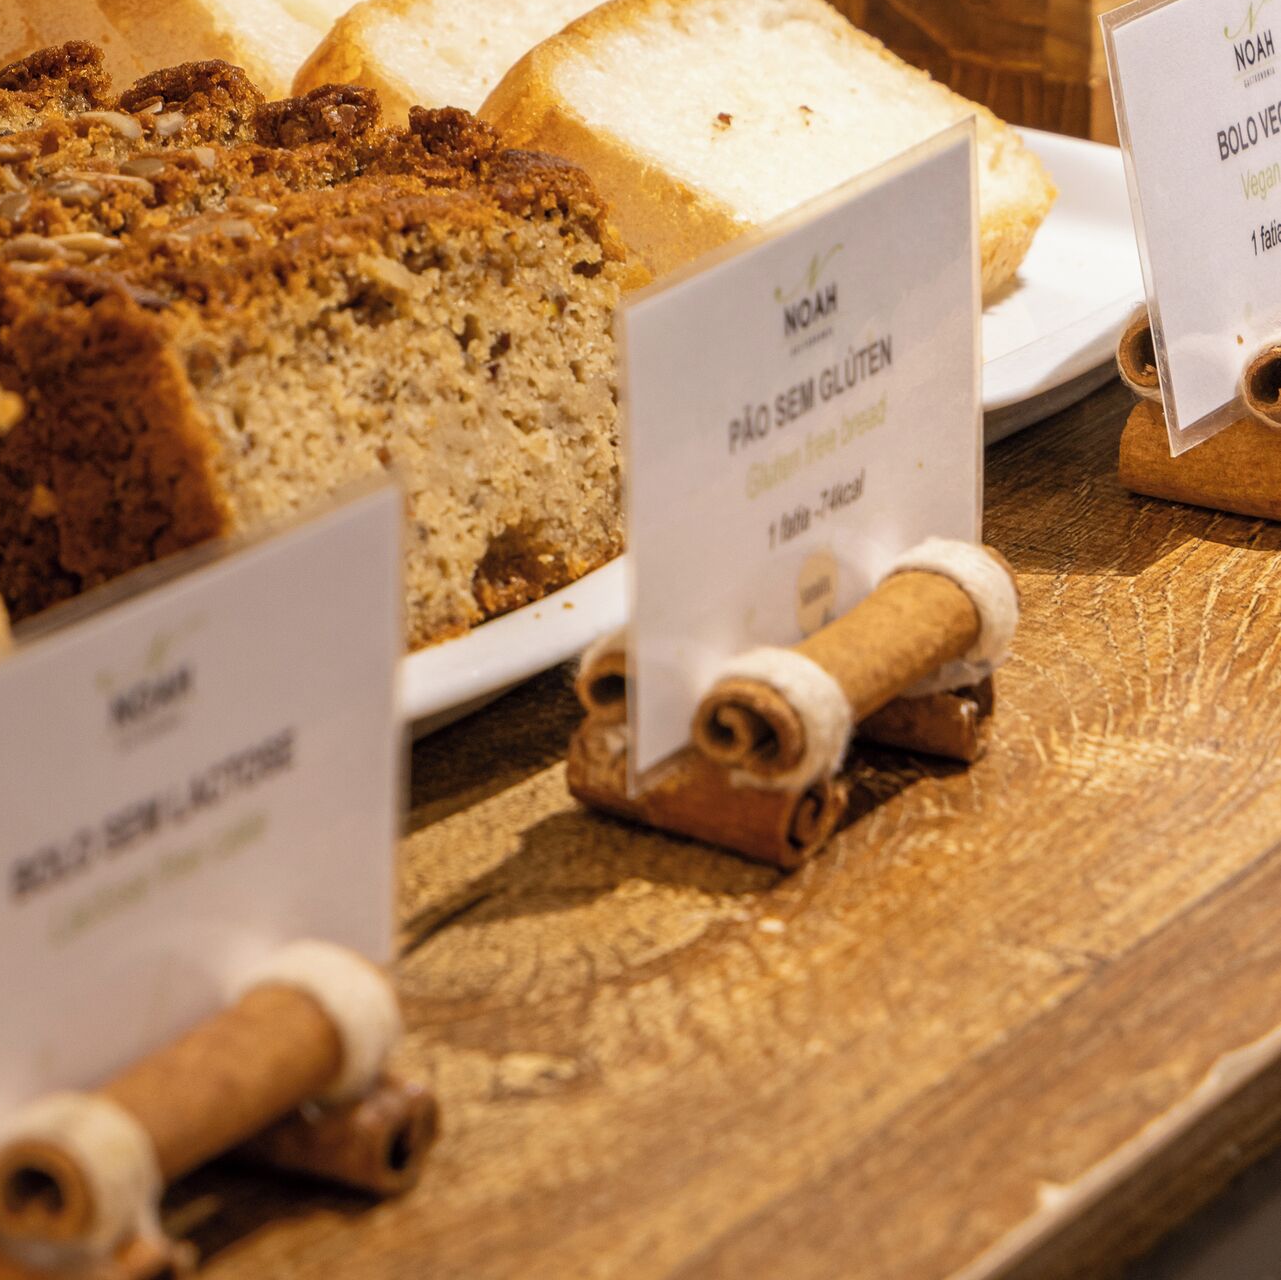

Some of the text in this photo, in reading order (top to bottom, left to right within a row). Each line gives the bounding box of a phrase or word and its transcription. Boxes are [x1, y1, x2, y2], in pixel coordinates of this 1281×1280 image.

[1233, 29, 1275, 72] NOAH
[1217, 116, 1258, 161] BOLO
[1251, 229, 1258, 256] 1
[784, 282, 839, 338] NOAH
[775, 377, 815, 428] SEM
